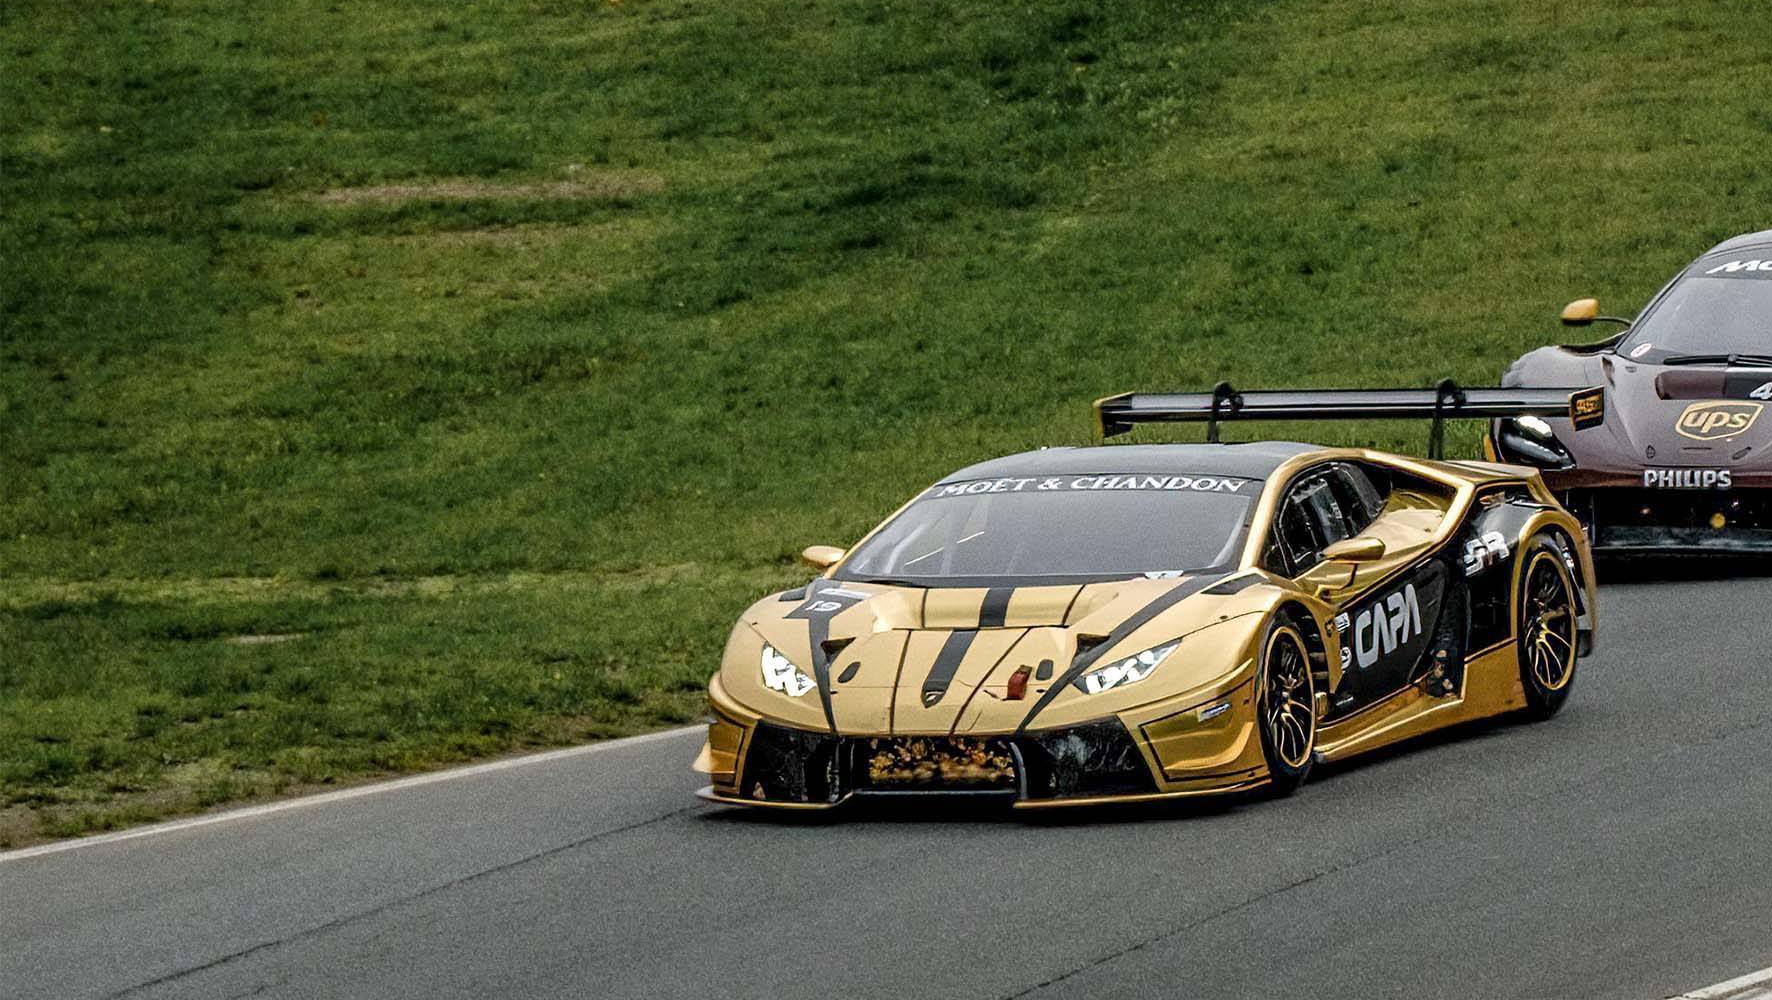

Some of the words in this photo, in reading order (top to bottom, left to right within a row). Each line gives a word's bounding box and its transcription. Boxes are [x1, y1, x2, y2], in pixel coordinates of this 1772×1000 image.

[1037, 478, 1062, 490] &
[1070, 477, 1245, 493] CHANDON
[1644, 470, 1732, 487] PHILIPS
[805, 600, 842, 611] 19
